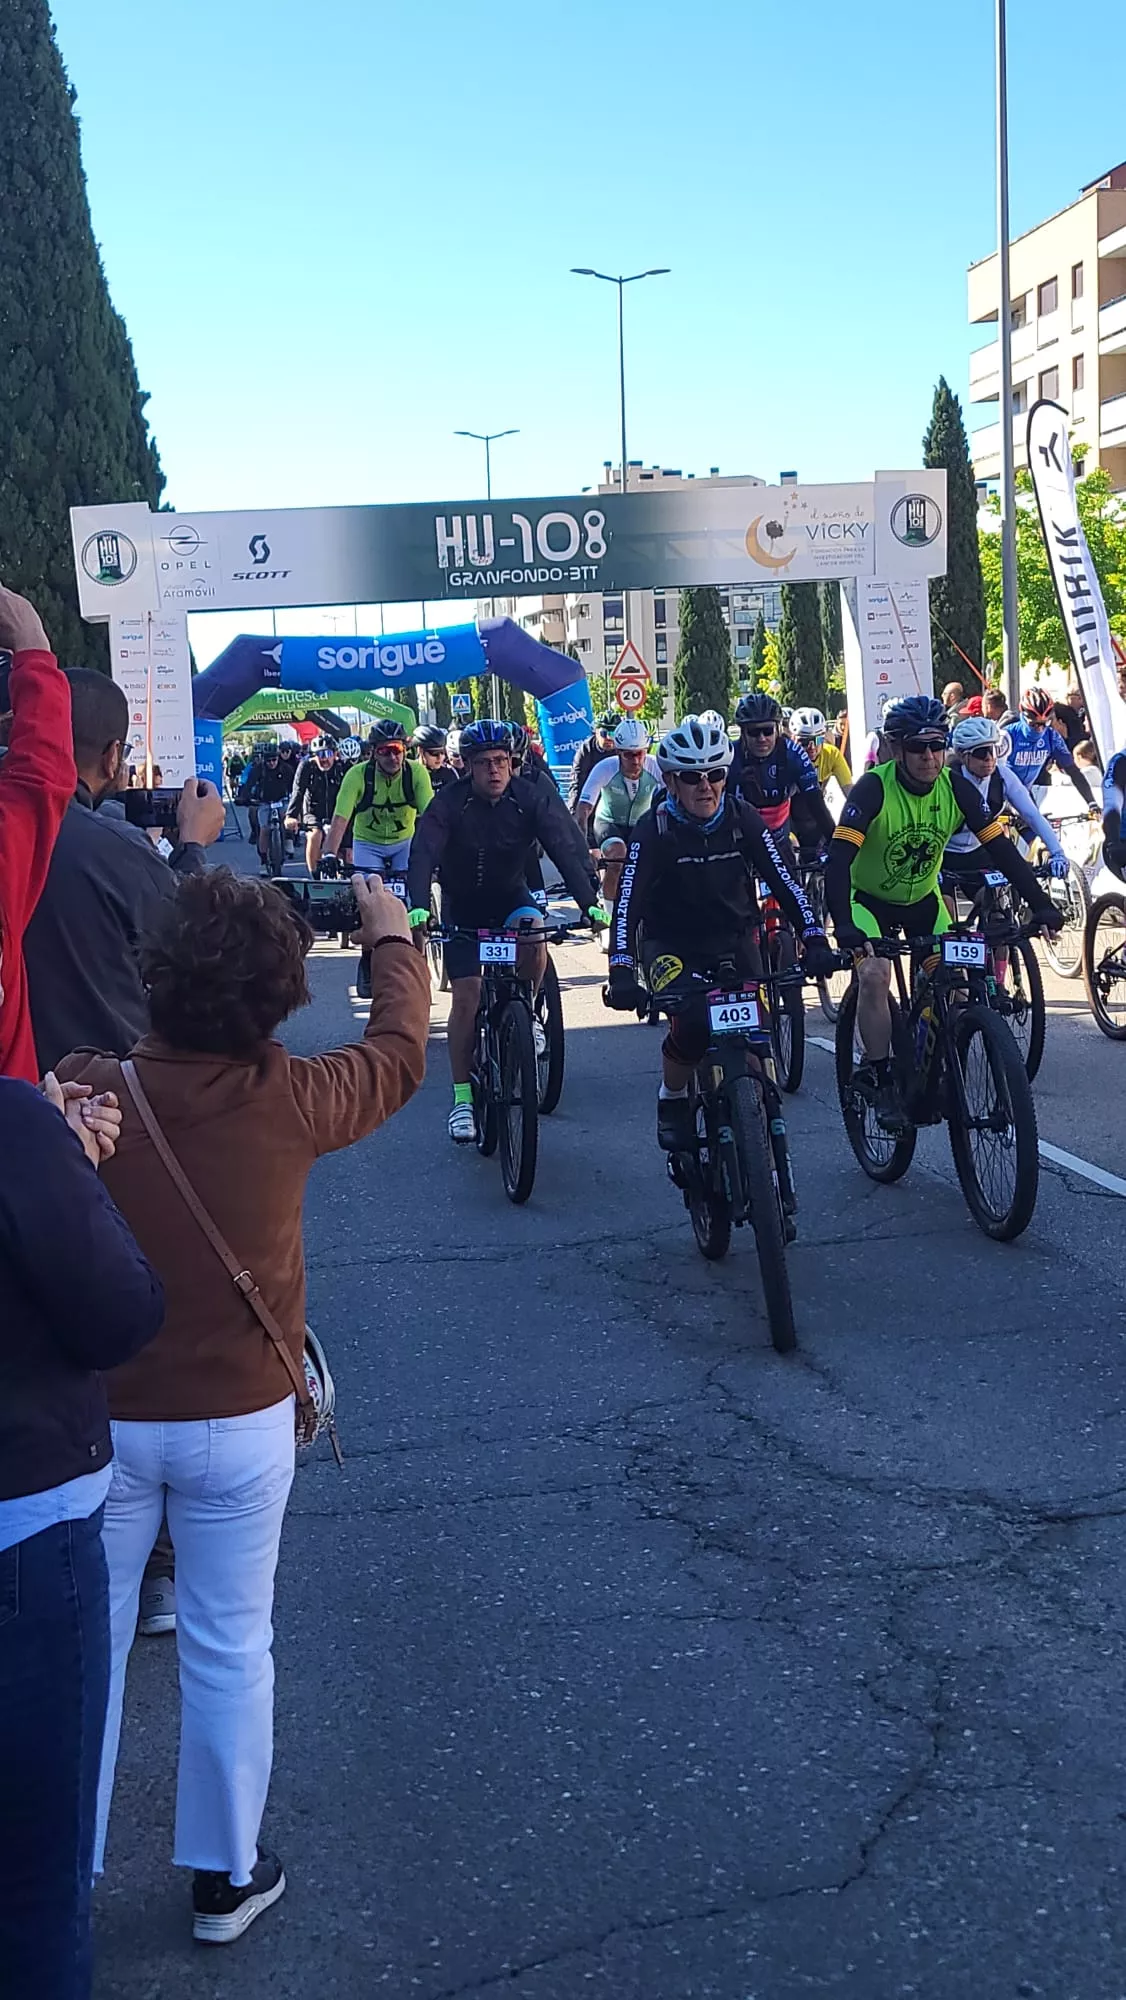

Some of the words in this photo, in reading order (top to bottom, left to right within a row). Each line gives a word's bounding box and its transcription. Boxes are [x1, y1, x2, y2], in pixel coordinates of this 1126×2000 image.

[436, 510, 607, 568] HU-108
[161, 560, 212, 571] OPEL
[231, 570, 292, 581] SCOTT
[622, 690, 641, 701] 20
[761, 828, 815, 925] www.zonabici.es
[616, 842, 641, 950] www.zonabici.es
[486, 946, 509, 957] 331
[952, 945, 979, 958] 159
[719, 1006, 751, 1023] 403
